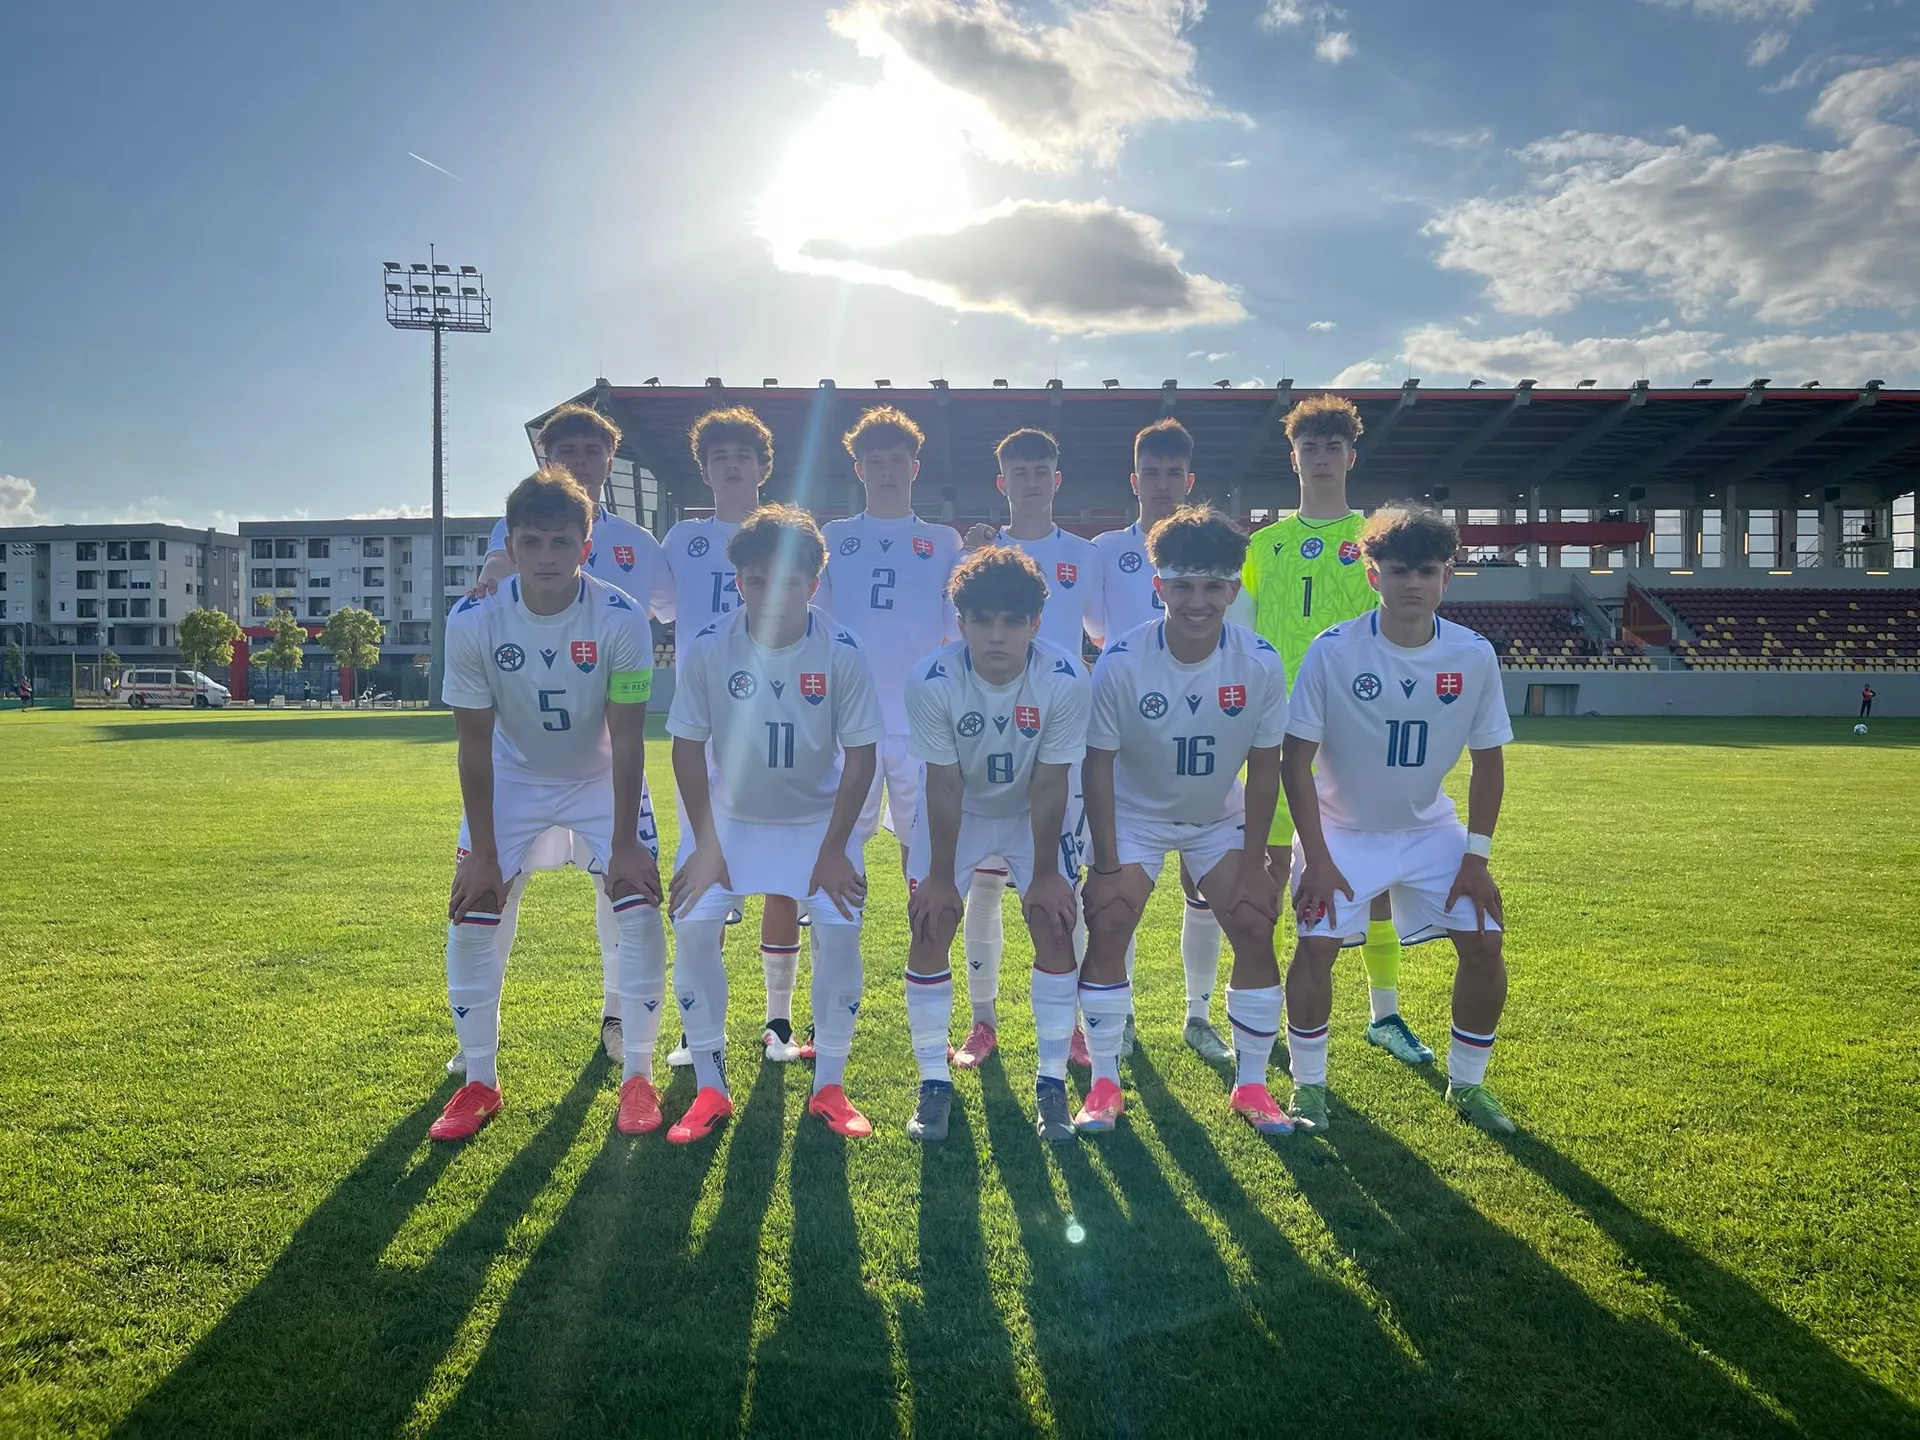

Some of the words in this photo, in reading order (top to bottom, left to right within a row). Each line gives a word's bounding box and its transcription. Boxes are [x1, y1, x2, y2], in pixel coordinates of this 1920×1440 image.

[711, 572, 746, 613] 13
[870, 568, 896, 610] 2
[1302, 576, 1313, 617] 1
[538, 689, 571, 732] 5
[765, 722, 795, 768] 11
[1172, 736, 1216, 776] 16
[1385, 720, 1429, 767] 10
[987, 752, 1015, 784] 8
